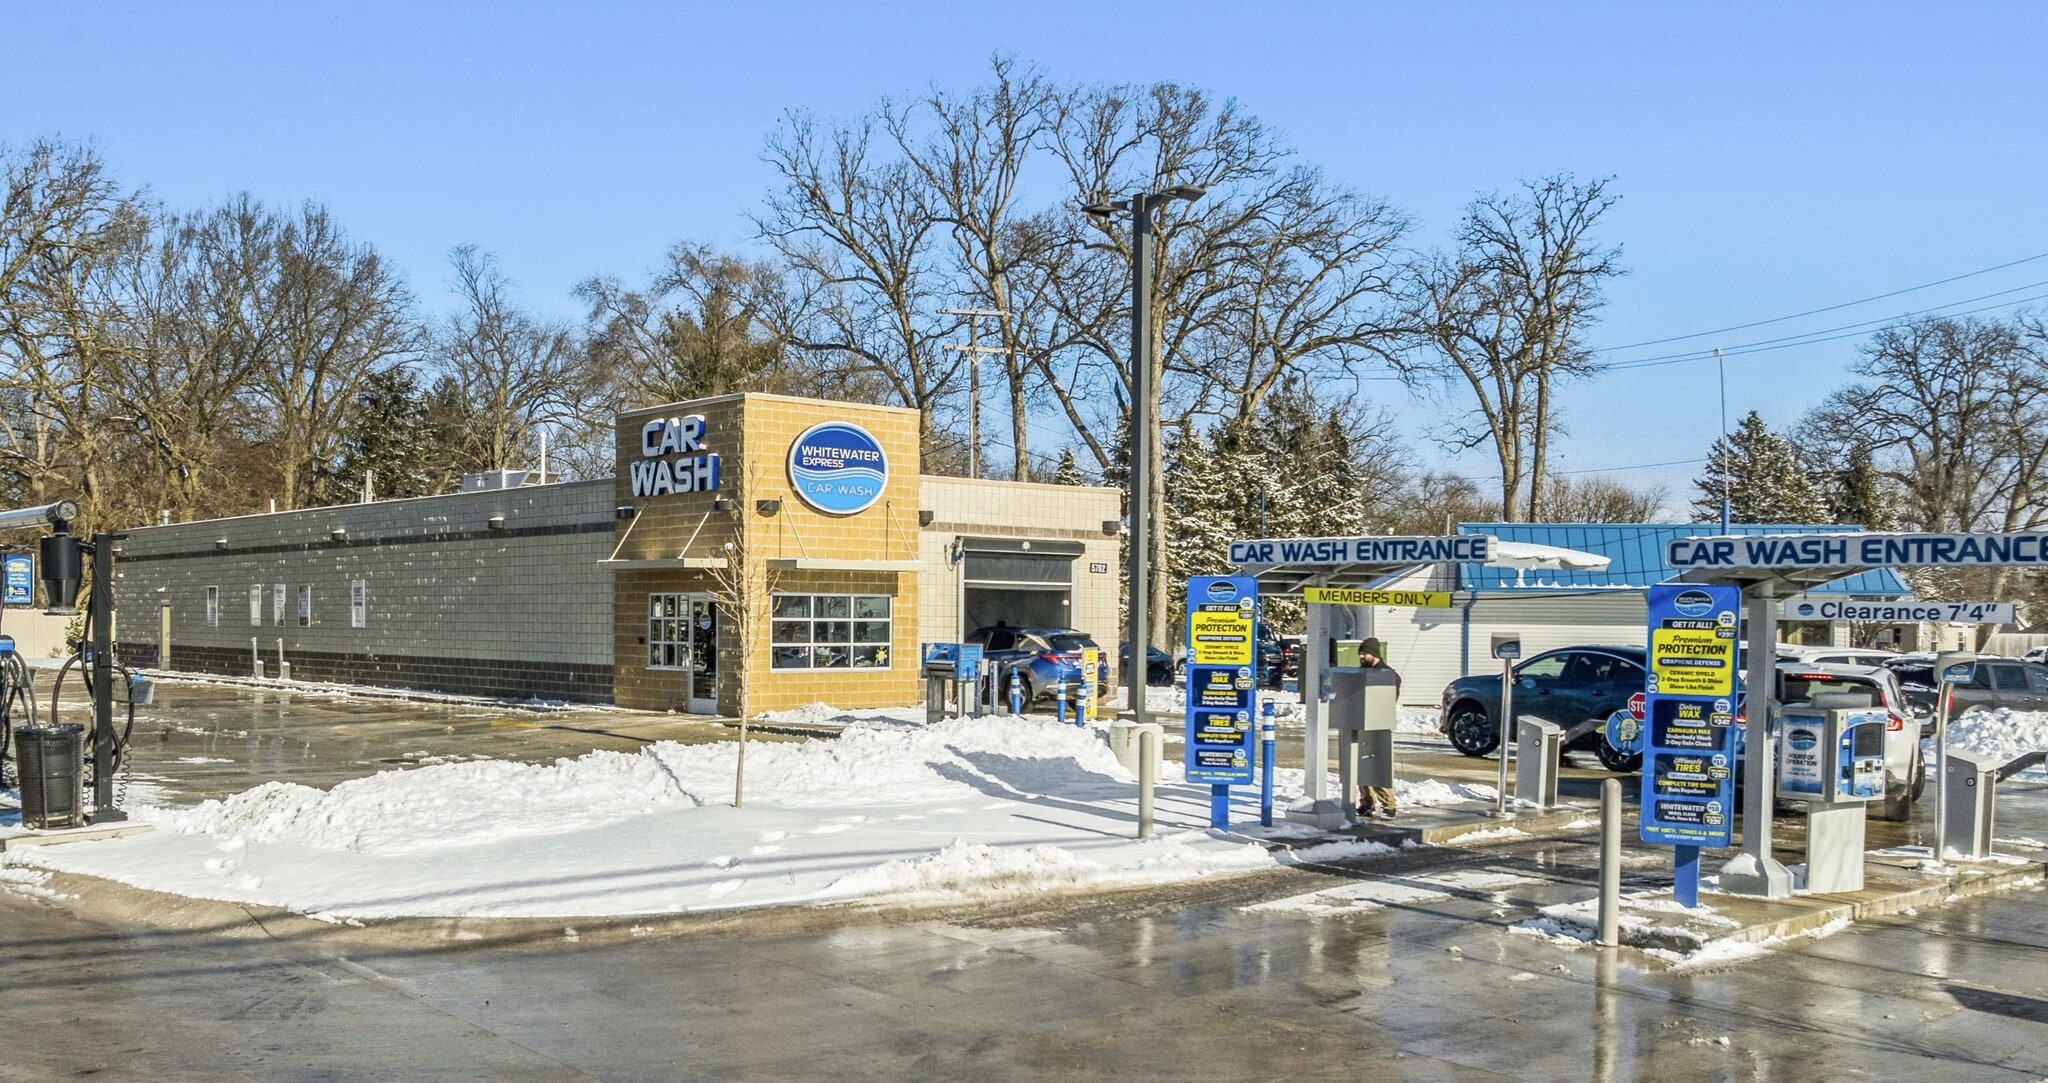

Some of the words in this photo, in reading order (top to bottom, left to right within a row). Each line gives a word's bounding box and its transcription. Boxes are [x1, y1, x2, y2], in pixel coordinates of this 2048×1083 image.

[642, 414, 706, 457] CAR
[802, 446, 880, 462] WHITEWATER
[803, 457, 844, 468] EXPRESS
[630, 453, 719, 497] WASH
[808, 482, 833, 493] CAR
[838, 485, 873, 496] WASH
[1231, 543, 1274, 562] CAR
[1281, 542, 1348, 562] WASH
[1356, 538, 1486, 560] ENTRANCE
[1670, 542, 1734, 564] CAR
[1746, 540, 1847, 564] WASH
[1318, 590, 1390, 604] MEMBERS
[1394, 592, 1432, 606] ONLY
[1820, 602, 1940, 620] Clearance
[1948, 604, 1997, 622] 7'4"
[1195, 624, 1247, 632] PROTECTION
[1672, 635, 1713, 644] Premium
[1658, 644, 1727, 655] PROTECTION
[1630, 701, 1646, 712] STO
[1676, 764, 1701, 772] TIRES
[1660, 803, 1705, 812] WHITEWATER
